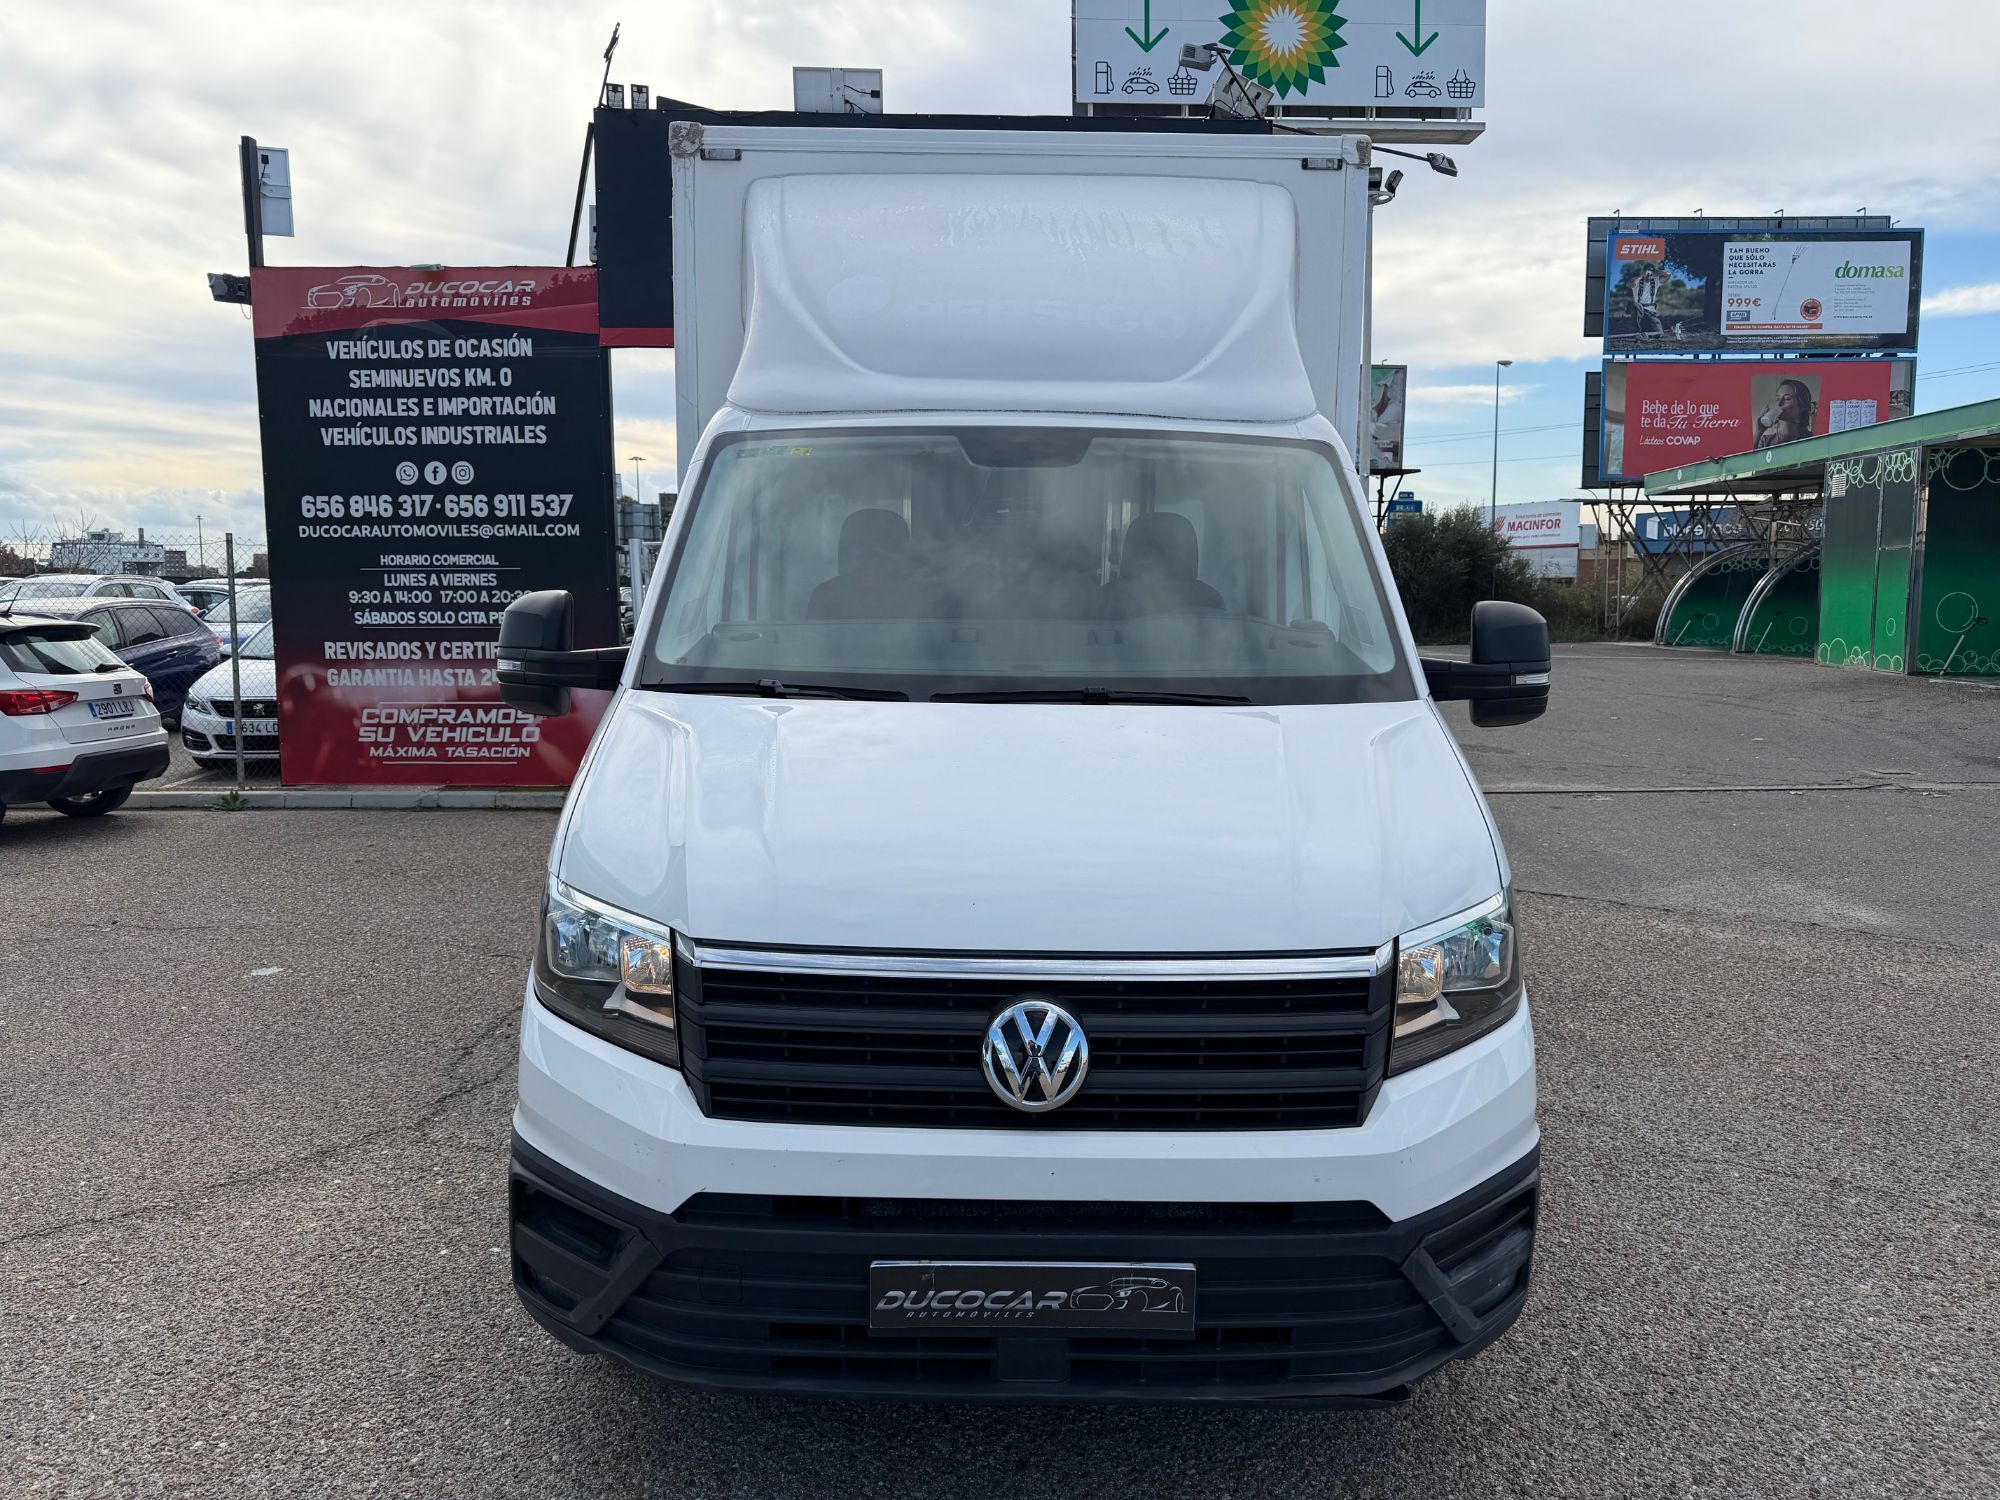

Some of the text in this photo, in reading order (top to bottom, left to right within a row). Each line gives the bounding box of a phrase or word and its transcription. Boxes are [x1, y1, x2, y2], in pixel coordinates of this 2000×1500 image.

[1621, 244, 1659, 254] STIHL
[1835, 260, 1904, 278] domasa
[405, 280, 536, 294] DUCOCAR
[1727, 297, 1761, 307] 999€
[326, 333, 532, 360] VEHÍCULOS DE OCASIÓN
[349, 368, 461, 388] SEMINUEVOS
[464, 367, 496, 387] KM.
[309, 391, 556, 417] NACIONALES E IMPORTACIÓN
[1641, 400, 1719, 416] Bebe de lo que
[1641, 416, 1651, 427] te
[1653, 414, 1666, 428] da
[1692, 414, 1742, 429] Tierra
[320, 422, 547, 446] VEHÍCULOS INDUSTRIALES
[1666, 436, 1701, 445] COVAP
[301, 495, 345, 518] 656
[349, 495, 393, 518] 846
[494, 494, 526, 517] 911
[531, 494, 574, 517] 537
[299, 523, 580, 539] DUCOCARAUTOMOVILES@GMAIL.COM
[1507, 518, 1561, 532] MACINFOR
[380, 554, 499, 566] HORARIO COMERCIAL
[384, 574, 497, 587] LUNES A VIERNES
[348, 591, 381, 604] 9:30
[383, 591, 392, 604] A
[394, 591, 432, 604] 14:00
[440, 590, 478, 604] 17:00
[480, 591, 490, 603] A
[354, 609, 416, 625] SÁBADOS
[419, 612, 455, 625] SOLO
[457, 612, 487, 624] CITA
[324, 641, 499, 660] REVISADOS Y CERTIF
[419, 669, 477, 687] HASTA
[96, 701, 118, 715] 2901
[361, 708, 535, 724] COMPRAMOS
[358, 726, 541, 742] SU VEHICULO
[369, 743, 531, 758] MÁXIMA TASACIÓN
[875, 1290, 1068, 1310] DUCOCAR
